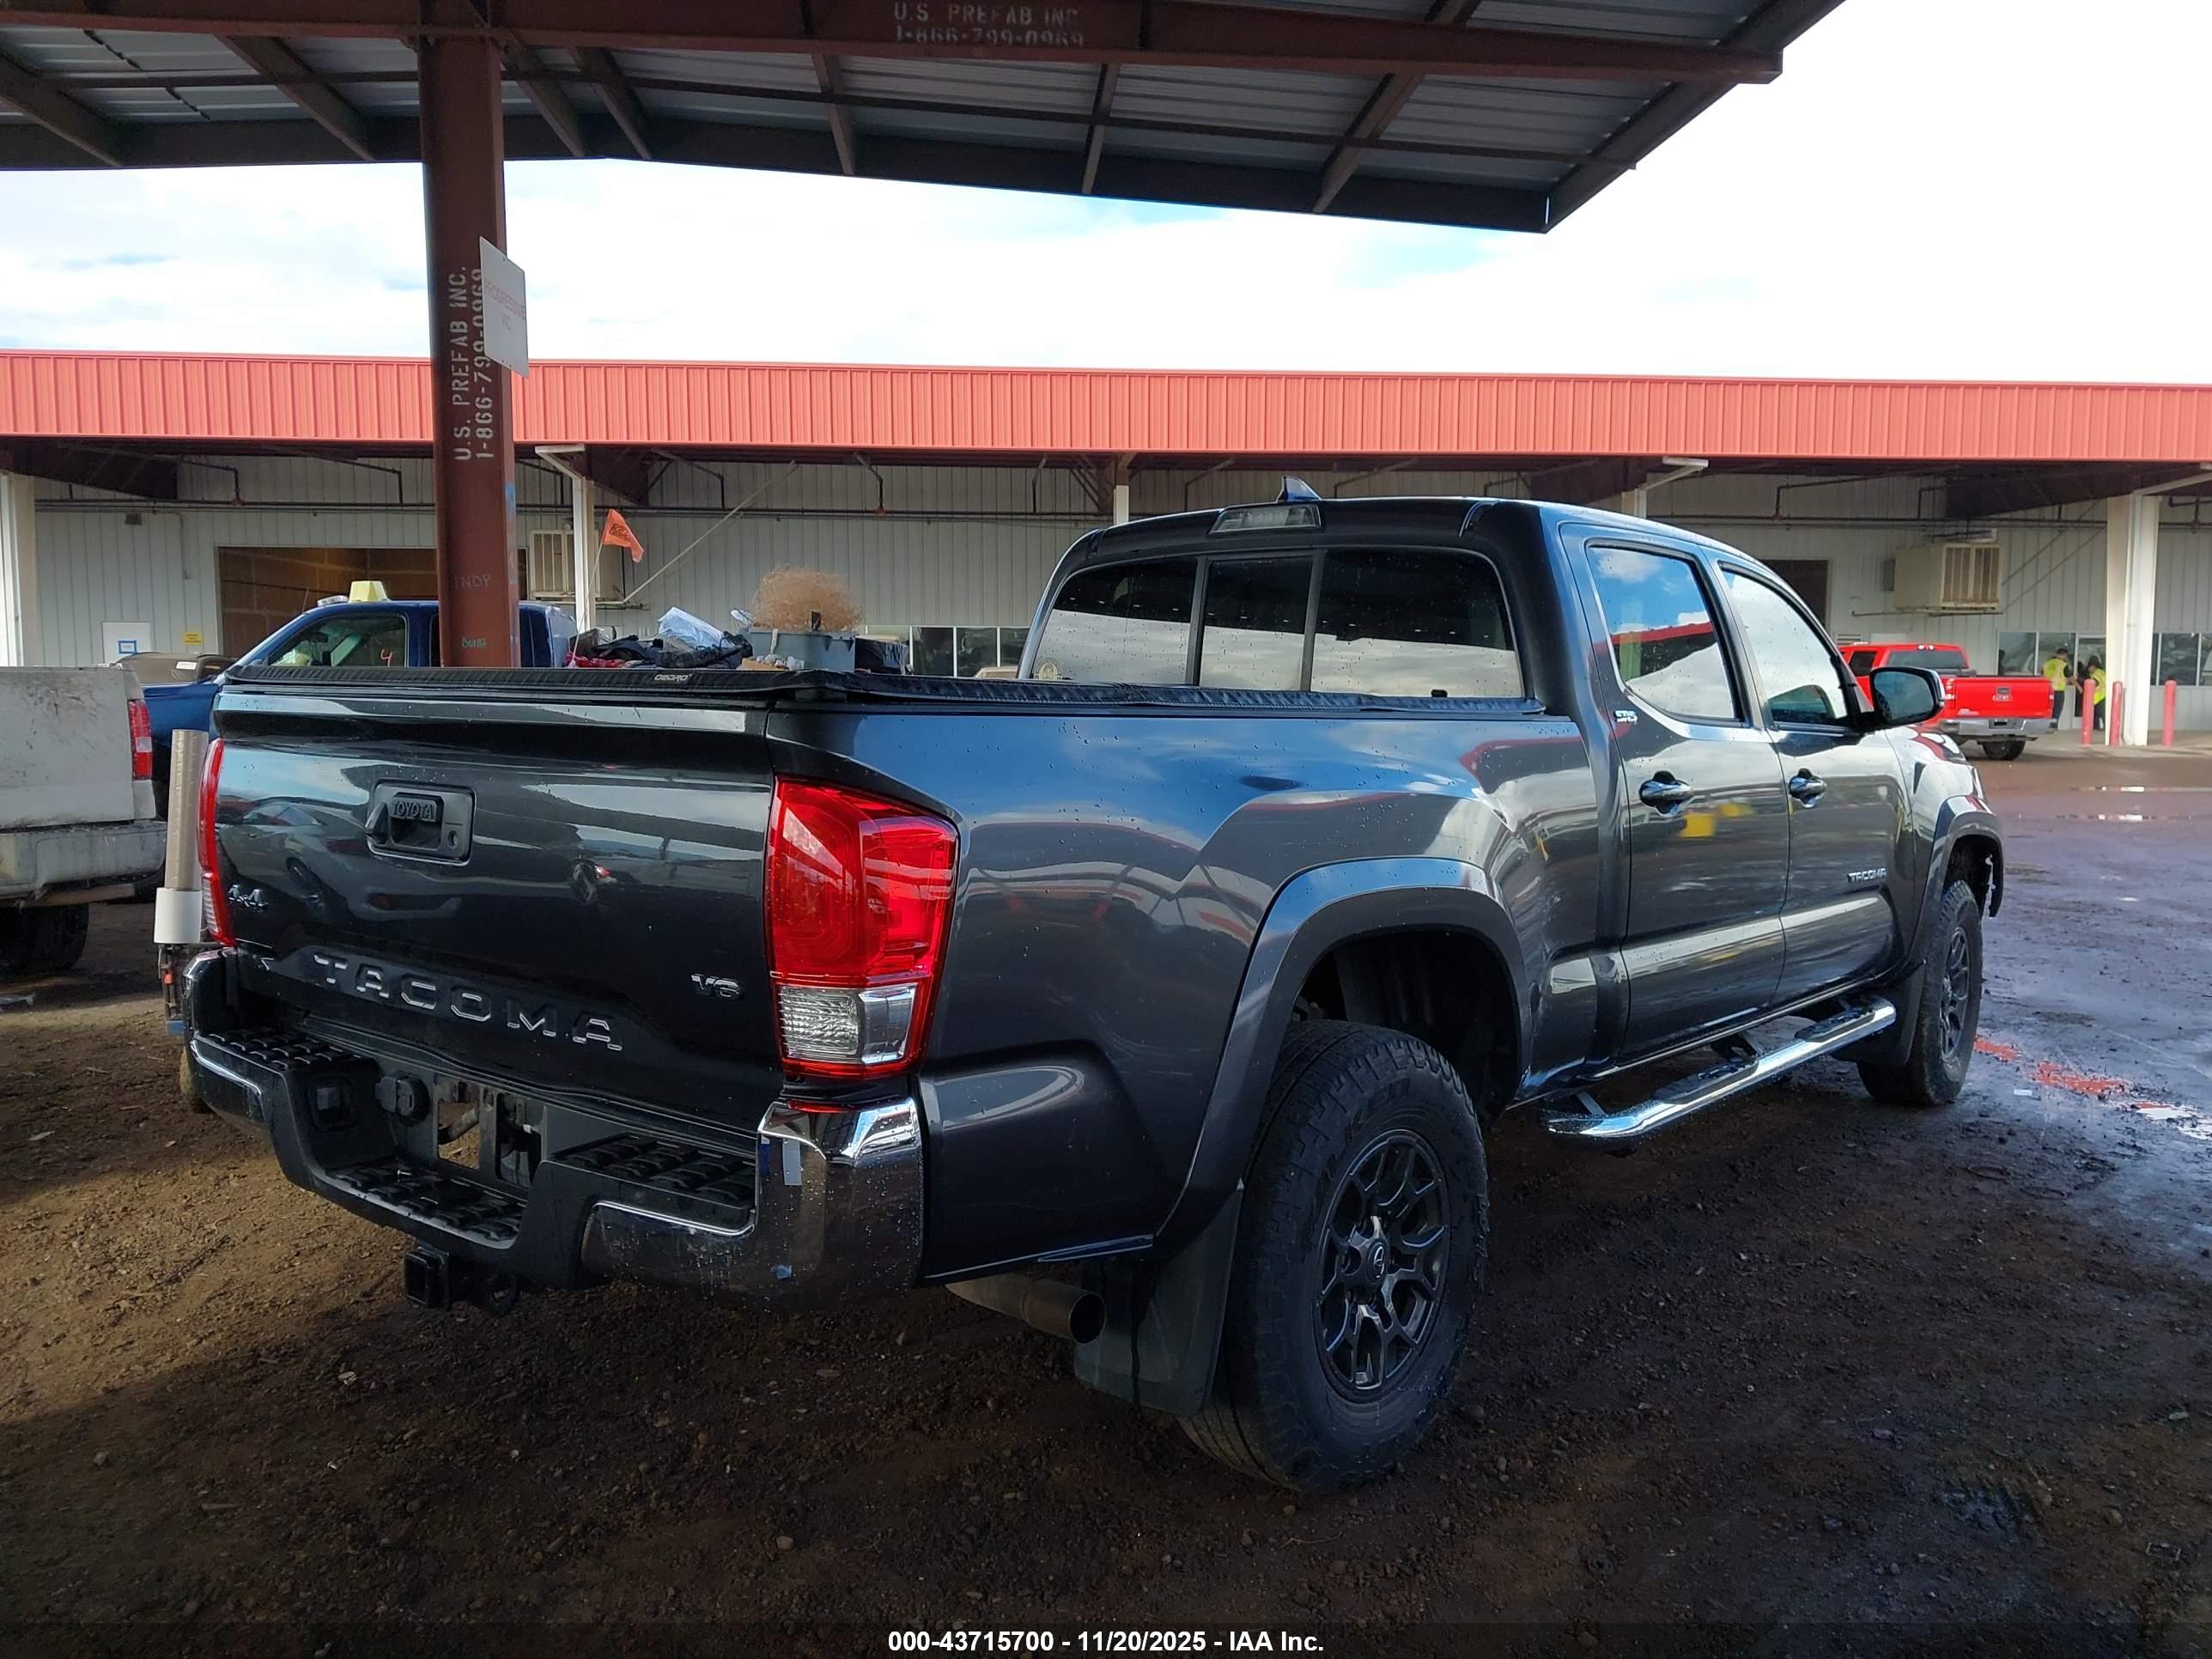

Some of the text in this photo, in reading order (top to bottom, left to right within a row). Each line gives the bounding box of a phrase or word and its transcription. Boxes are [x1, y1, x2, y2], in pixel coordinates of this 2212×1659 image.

[894, 2, 934, 21] U.S.
[948, 3, 1032, 25] PREFAB
[447, 266, 471, 460] U.S. PREFAB INC.
[392, 799, 434, 819] TOYOTA
[690, 971, 744, 1000] V6
[313, 953, 624, 1051] TACOMA
